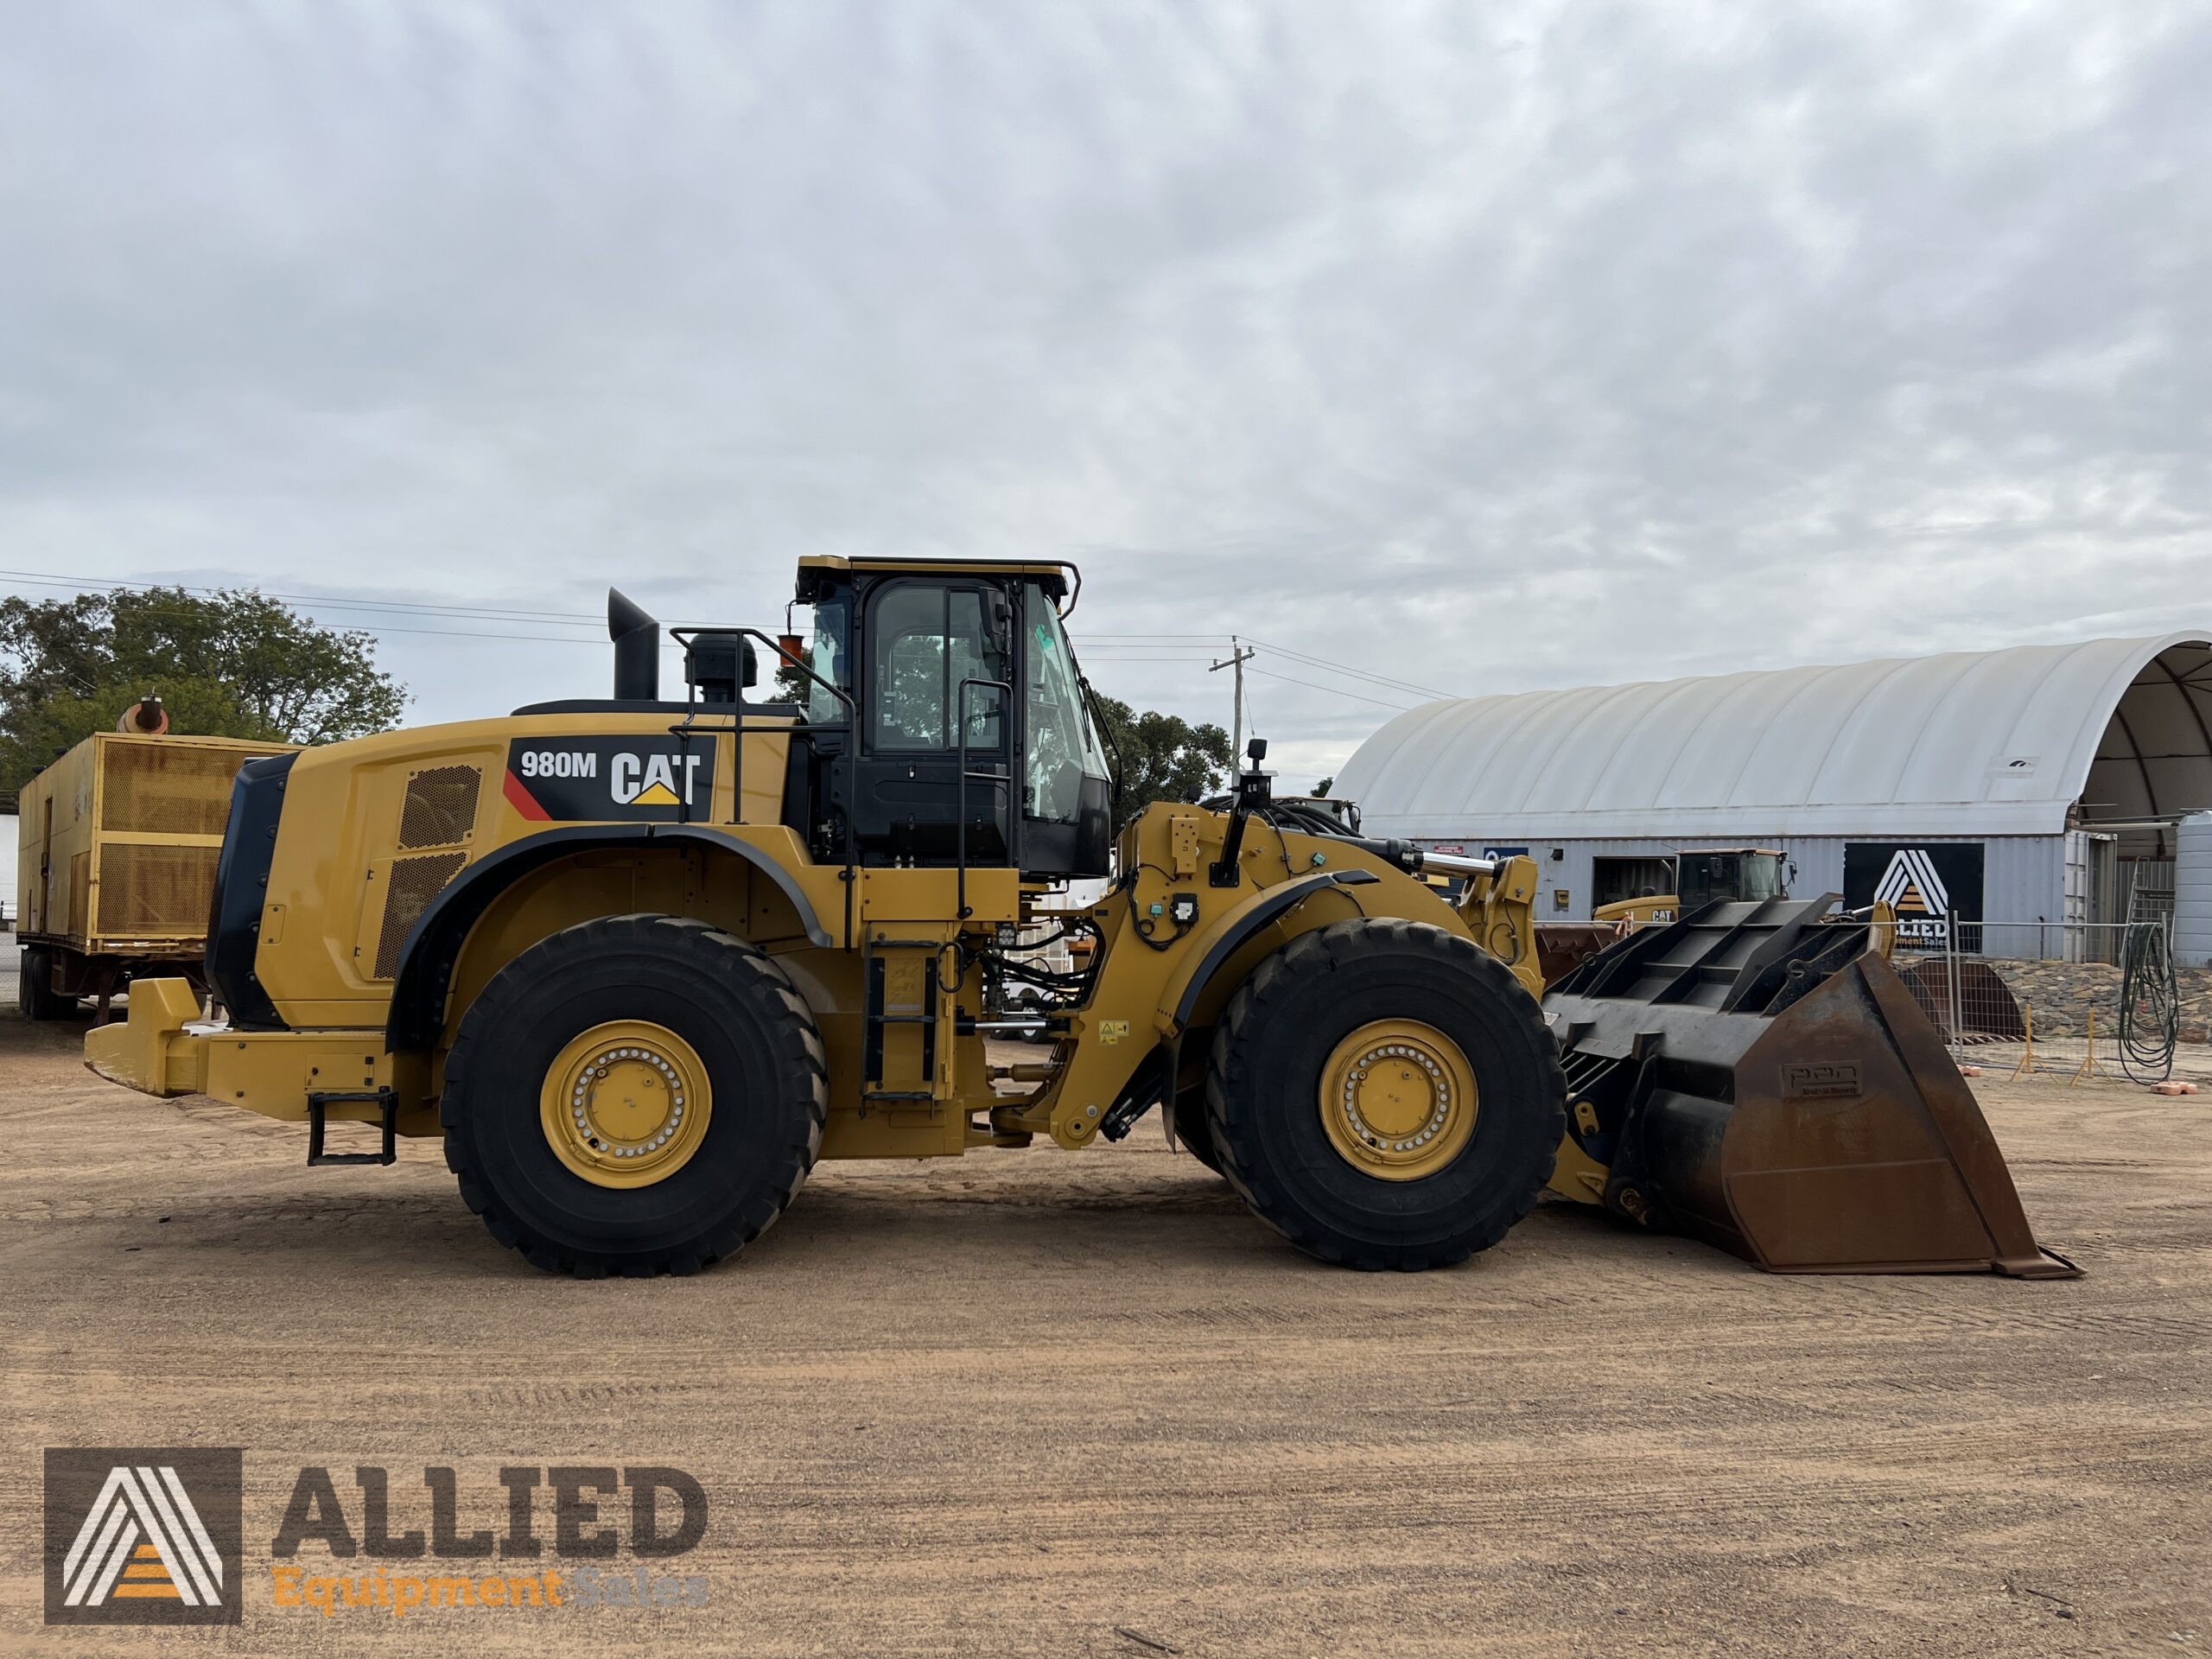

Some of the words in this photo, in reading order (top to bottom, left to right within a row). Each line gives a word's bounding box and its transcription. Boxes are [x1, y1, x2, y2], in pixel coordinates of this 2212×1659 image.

[521, 751, 596, 778] 980M
[611, 752, 701, 805] CAT
[1652, 910, 1671, 923] CAT
[1896, 918, 1948, 937] LIED
